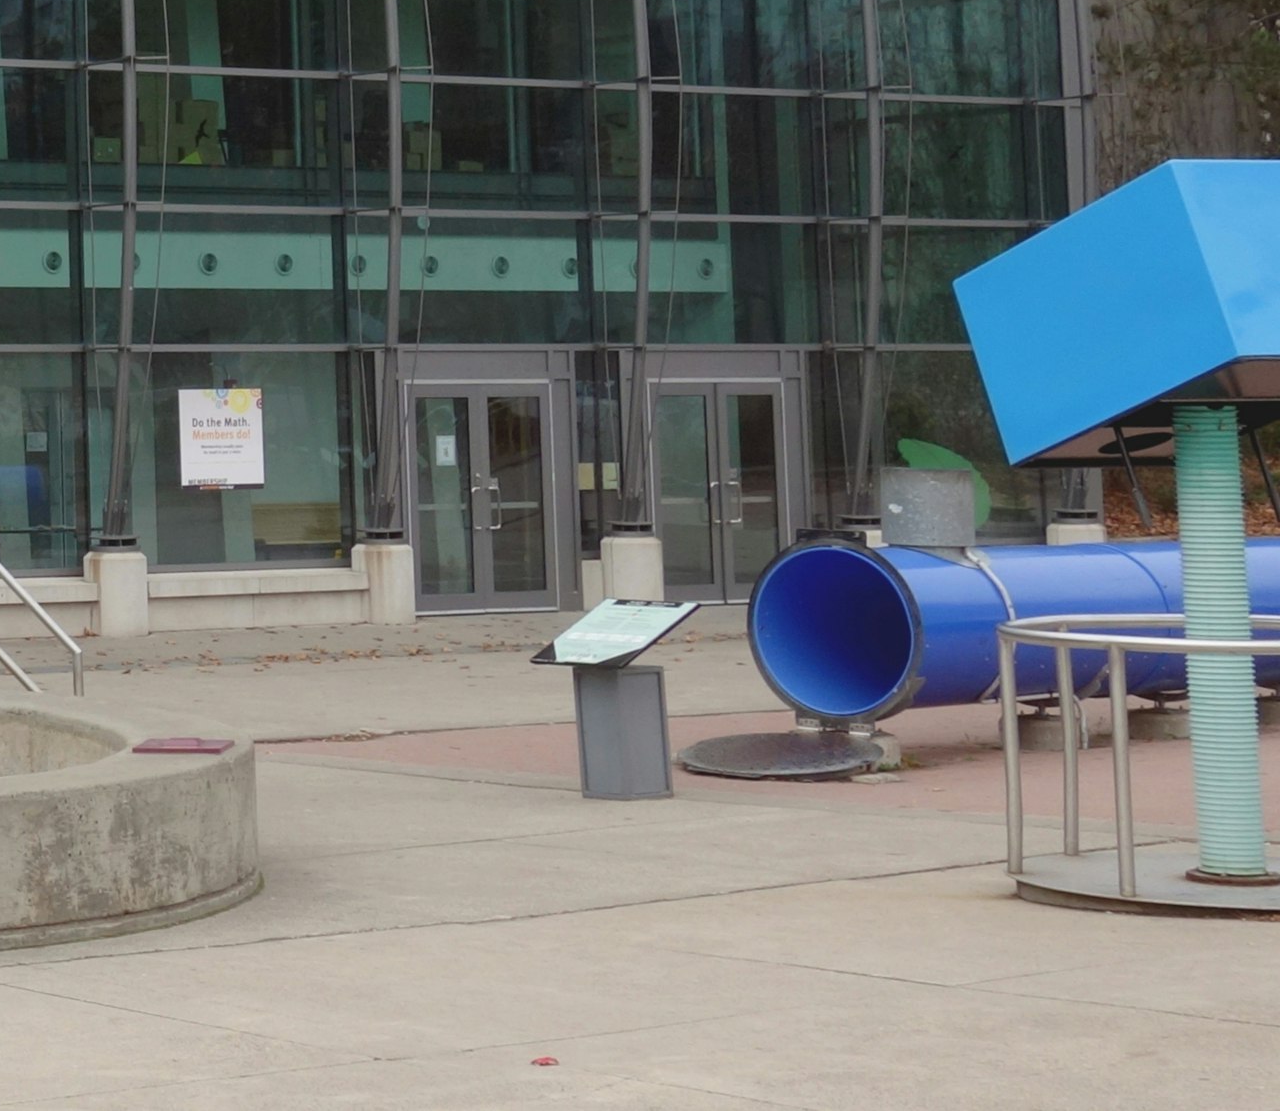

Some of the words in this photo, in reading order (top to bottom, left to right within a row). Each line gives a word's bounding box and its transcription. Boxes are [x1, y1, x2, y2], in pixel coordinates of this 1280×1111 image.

[191, 417, 205, 428] Do
[206, 417, 222, 428] the
[224, 417, 251, 428] Math.
[192, 430, 234, 440] Members
